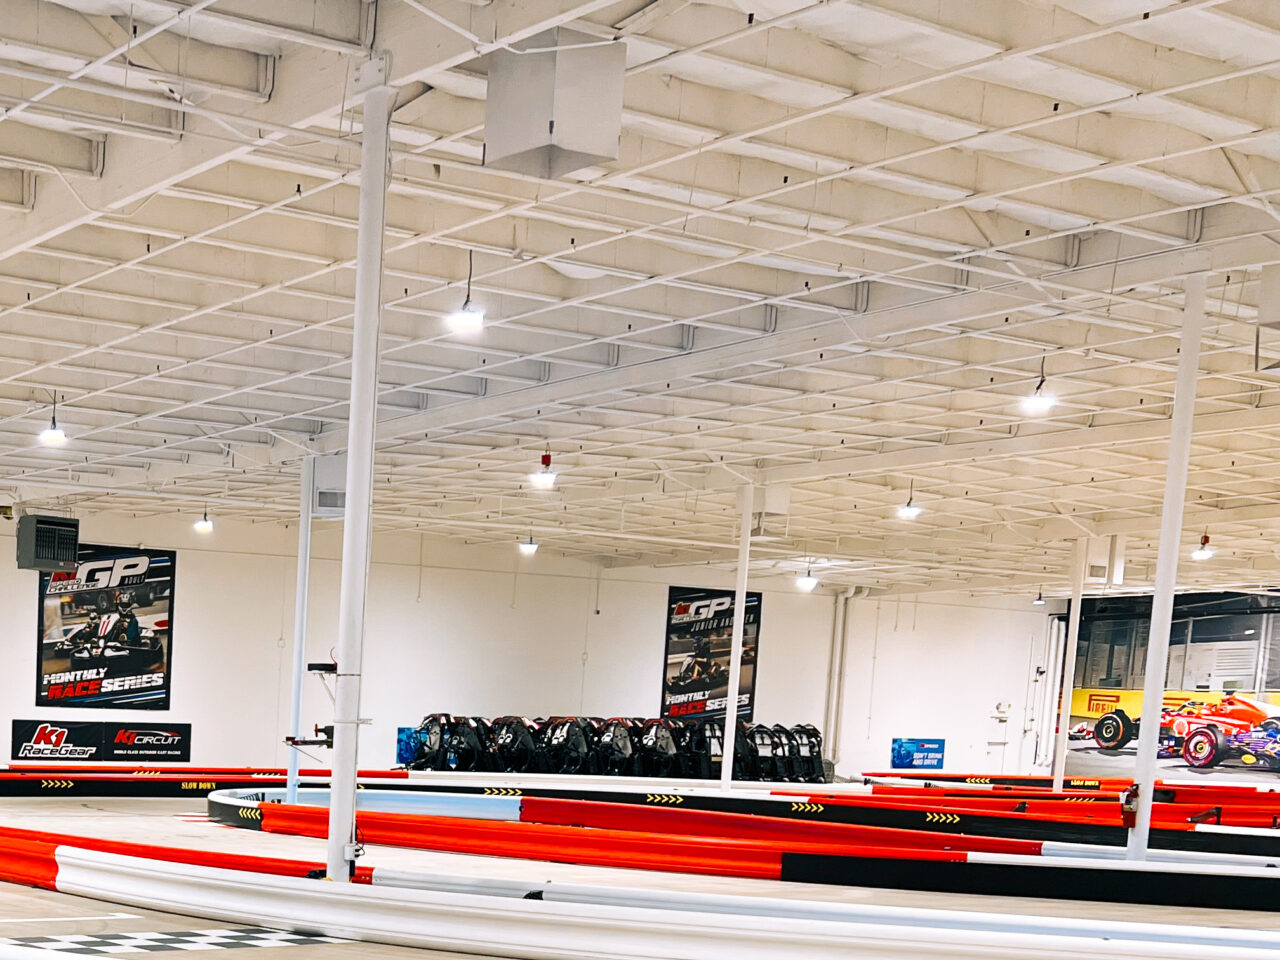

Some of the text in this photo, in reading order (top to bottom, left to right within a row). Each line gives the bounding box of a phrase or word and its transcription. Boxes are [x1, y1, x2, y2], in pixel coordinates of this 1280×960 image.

[77, 556, 150, 588] GP
[124, 575, 145, 584] ADULT
[691, 597, 732, 619] GP
[42, 667, 108, 684] MONTHLY
[47, 672, 165, 699] RACE SERIES
[666, 690, 711, 705] MONTHLY
[31, 724, 68, 747] K1
[19, 744, 96, 757] RaceGear
